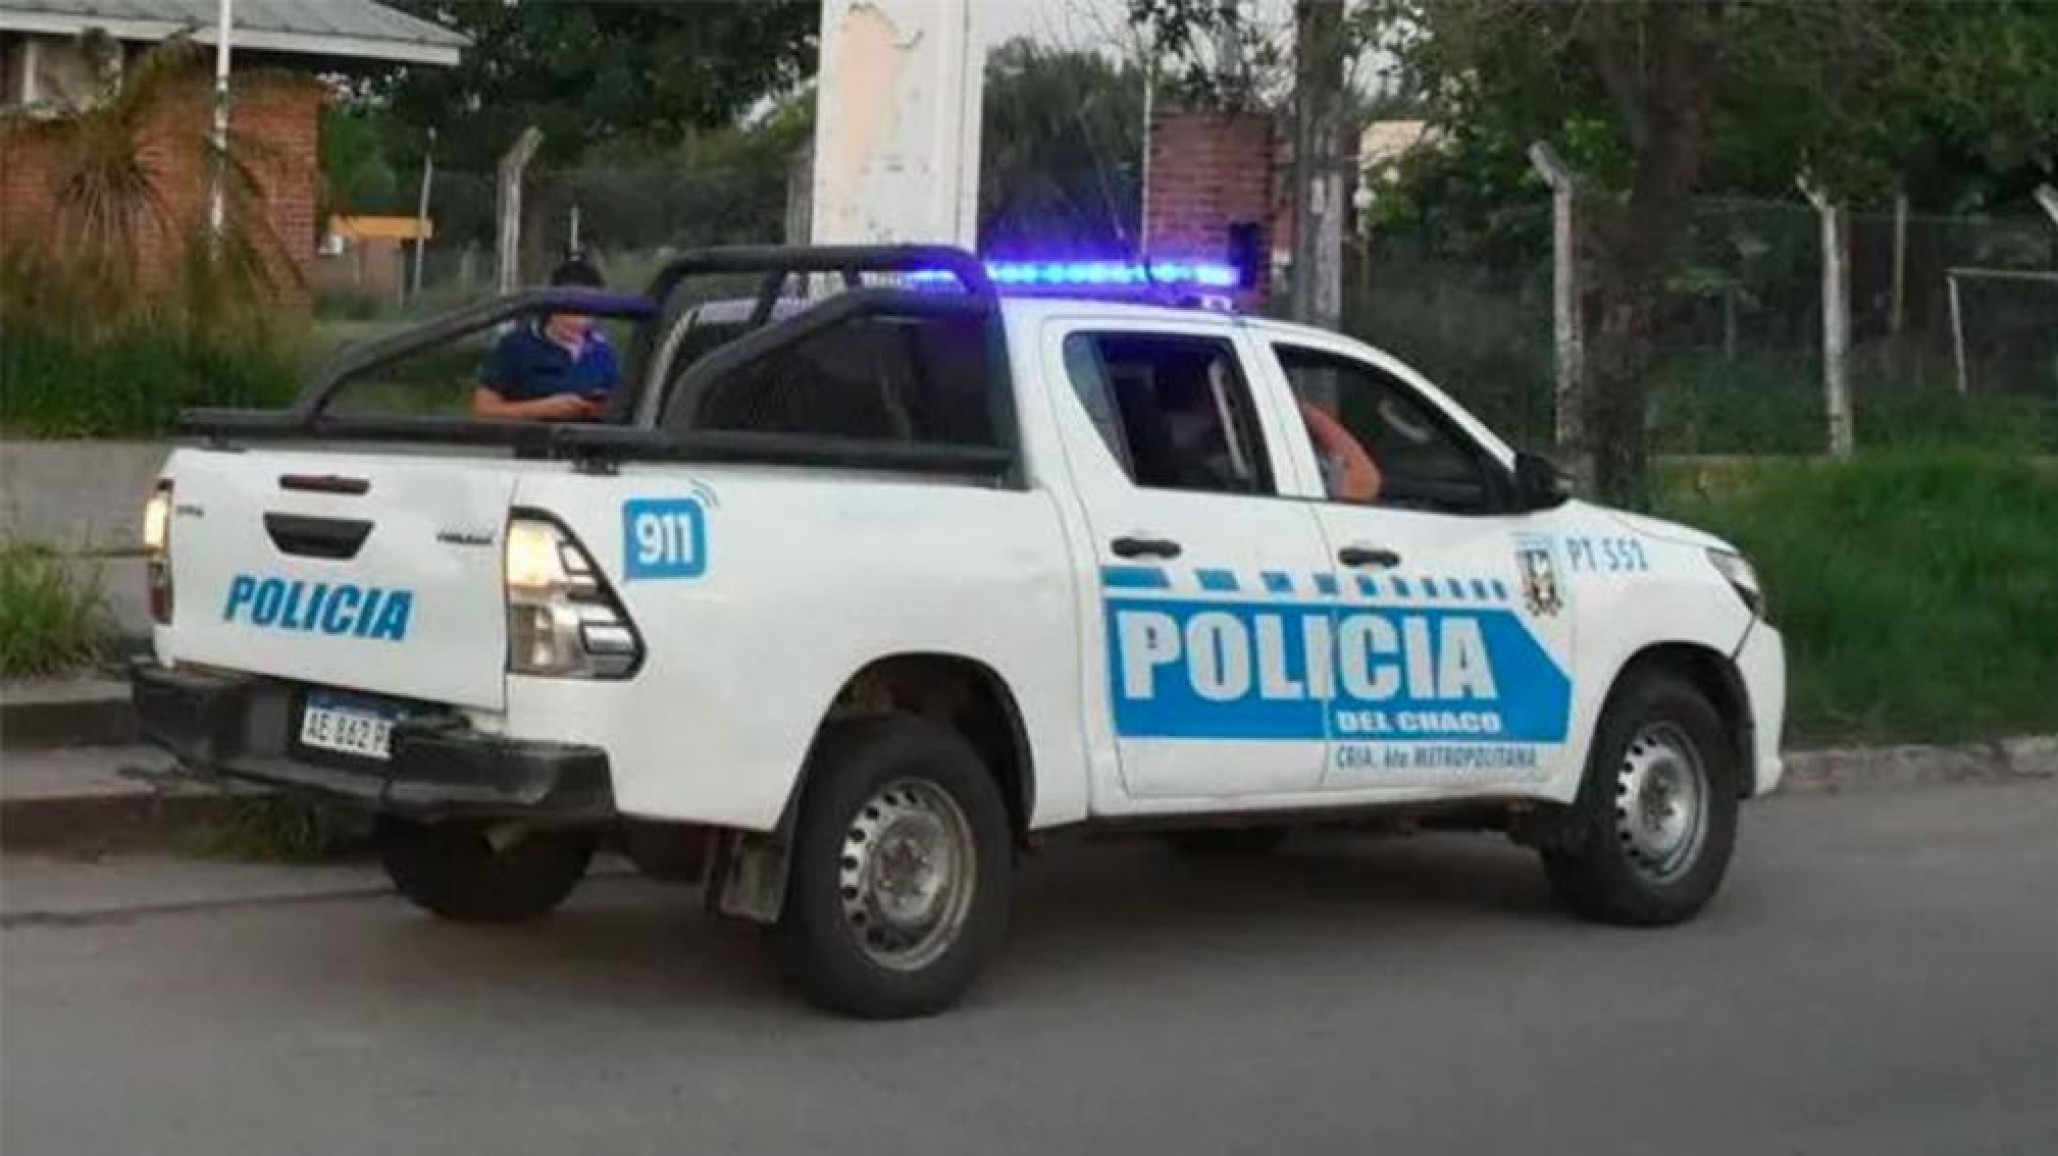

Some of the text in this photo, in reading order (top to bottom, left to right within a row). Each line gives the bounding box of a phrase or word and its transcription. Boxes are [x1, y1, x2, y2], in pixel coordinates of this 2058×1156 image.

[636, 512, 694, 564] 911
[1566, 536, 1598, 572] PT
[1602, 537, 1650, 572] 552
[223, 573, 412, 641] POLICIA
[1117, 610, 1498, 701] POLICIA
[308, 711, 330, 741] AE
[372, 721, 388, 752] P
[1336, 711, 1501, 733] DEL CHACO
[1415, 746, 1540, 767] METROPOLITANA
